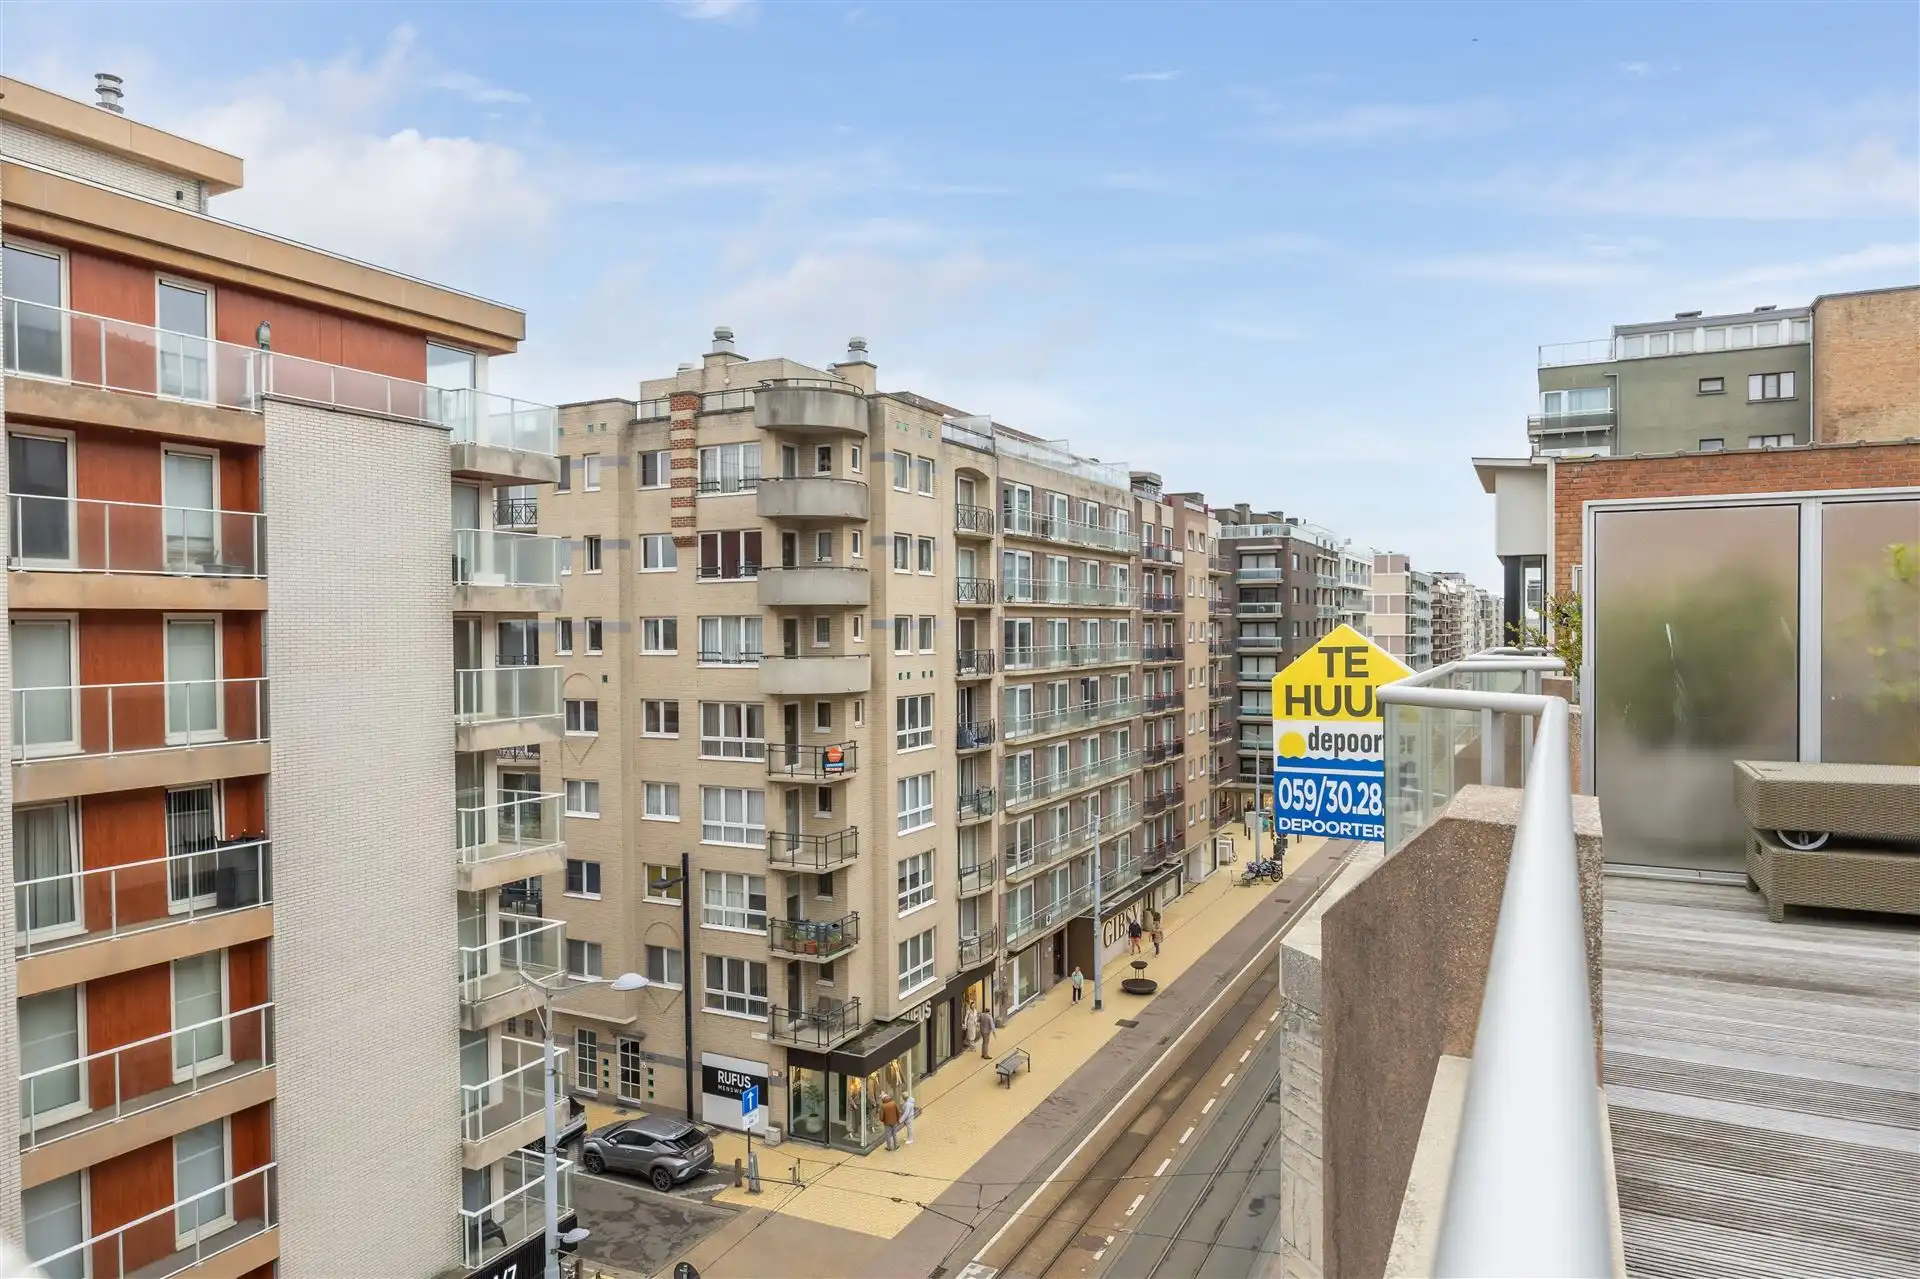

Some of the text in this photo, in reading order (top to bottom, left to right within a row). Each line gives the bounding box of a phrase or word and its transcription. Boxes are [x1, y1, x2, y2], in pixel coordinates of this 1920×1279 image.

[1317, 646, 1369, 678] TE
[1307, 725, 1384, 758] depoor
[717, 1070, 751, 1089] RUFUS
